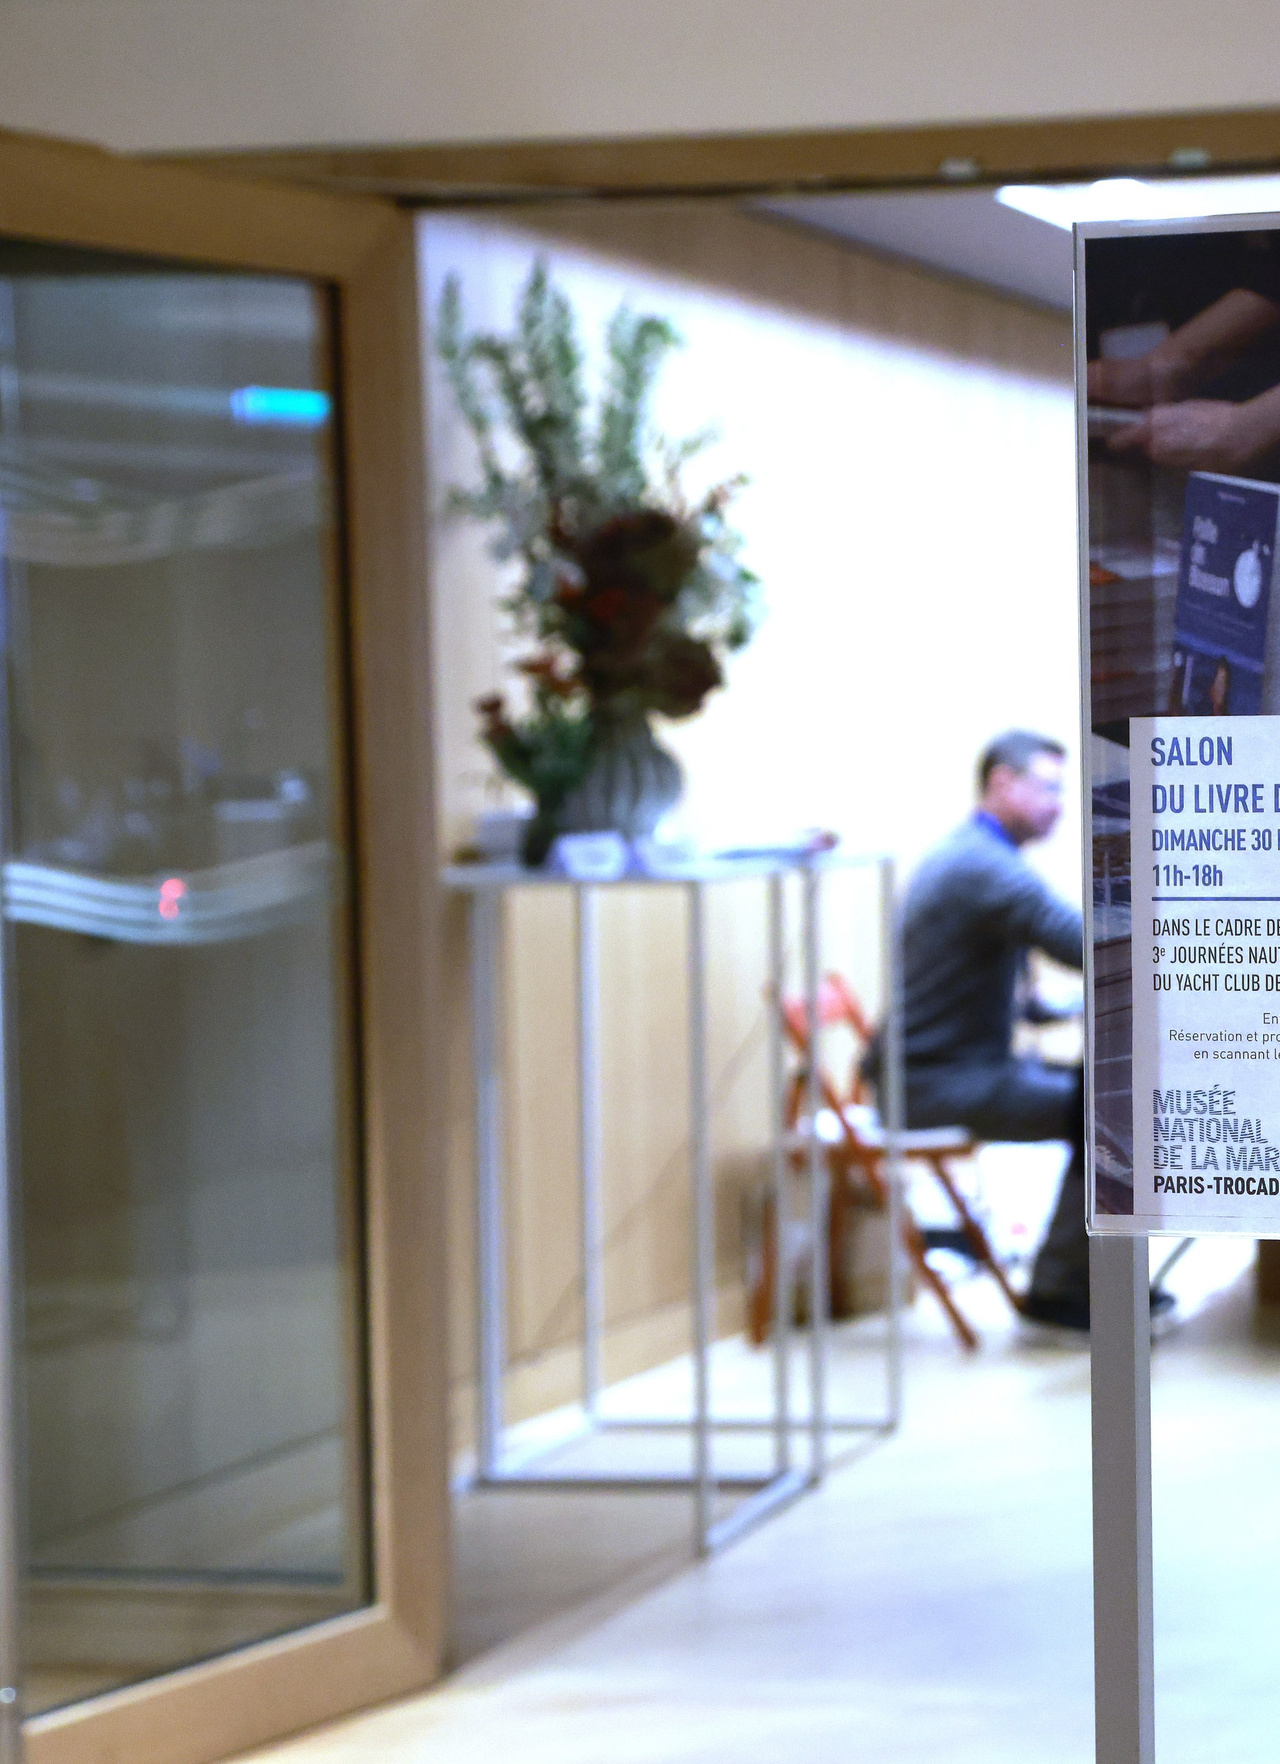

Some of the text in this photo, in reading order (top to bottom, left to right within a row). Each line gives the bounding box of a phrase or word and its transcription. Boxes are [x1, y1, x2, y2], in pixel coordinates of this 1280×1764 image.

[1151, 736, 1233, 766] SALON
[1152, 784, 1185, 814] DU
[1194, 784, 1265, 813] LIVRE
[1152, 829, 1246, 851] DIMANCHE
[1251, 829, 1272, 851] 30
[1152, 864, 1223, 887] 11h-18h
[1152, 919, 1190, 936] DANS
[1195, 919, 1210, 936] LE
[1215, 919, 1261, 936] CADRE
[1170, 942, 1244, 964] JOURNÉES
[1153, 973, 1172, 991] DU
[1177, 974, 1220, 991] YACHT
[1224, 974, 1260, 992] CLUB
[1169, 1029, 1242, 1042] Réservation
[1246, 1032, 1258, 1042] et
[1193, 1050, 1209, 1060] en
[1212, 1050, 1270, 1060] scannant
[1153, 1084, 1236, 1115] MUSÉE
[1153, 1117, 1268, 1144] NATIONAL
[1153, 1145, 1183, 1170] DE
[1190, 1145, 1219, 1171] LA
